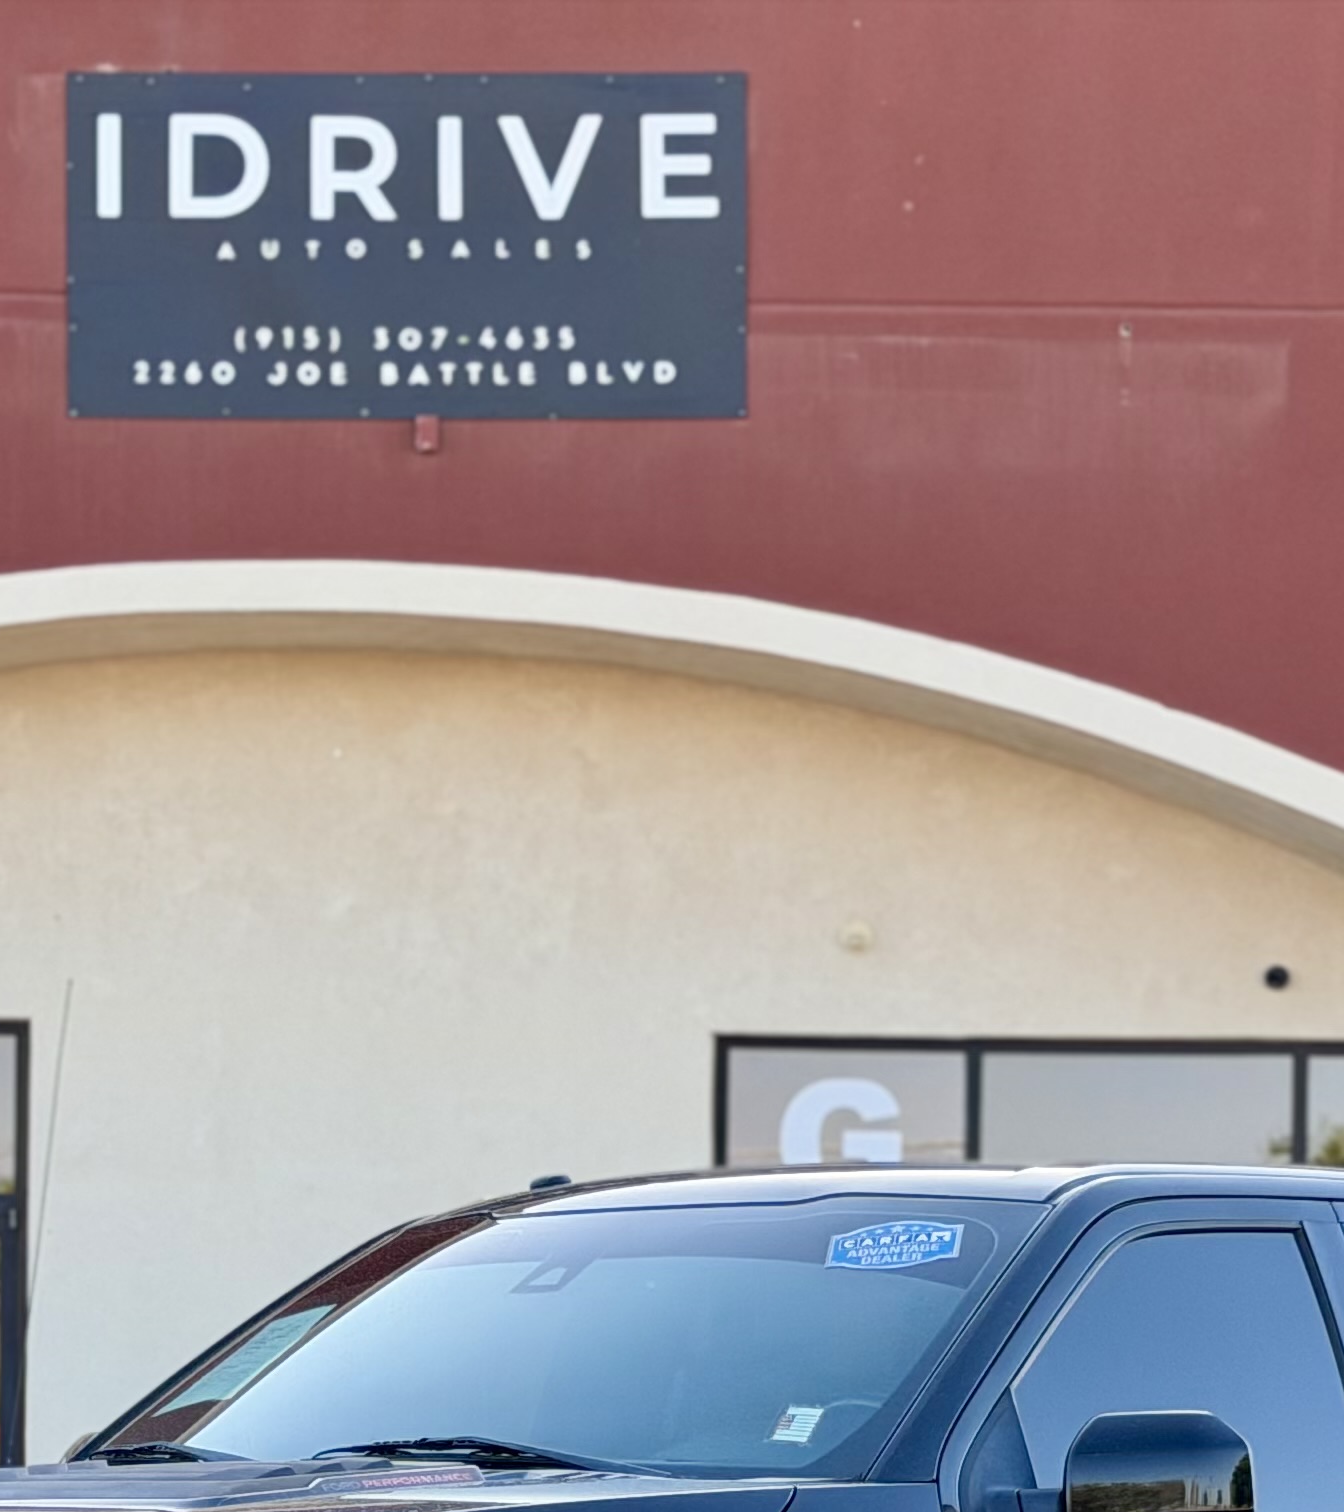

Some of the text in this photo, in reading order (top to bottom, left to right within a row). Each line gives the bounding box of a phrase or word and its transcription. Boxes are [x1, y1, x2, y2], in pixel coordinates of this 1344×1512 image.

[96, 112, 721, 221] IDRIVE
[216, 238, 592, 261] AUTO SALES
[234, 325, 341, 353] (915)
[133, 359, 677, 387] 2260 JOE BATTLE BLVD
[778, 1077, 904, 1165] G
[846, 1242, 940, 1259] ADVANTAGE
[860, 1252, 923, 1265] DEALER
[363, 1473, 470, 1488] PERFORMANCE
